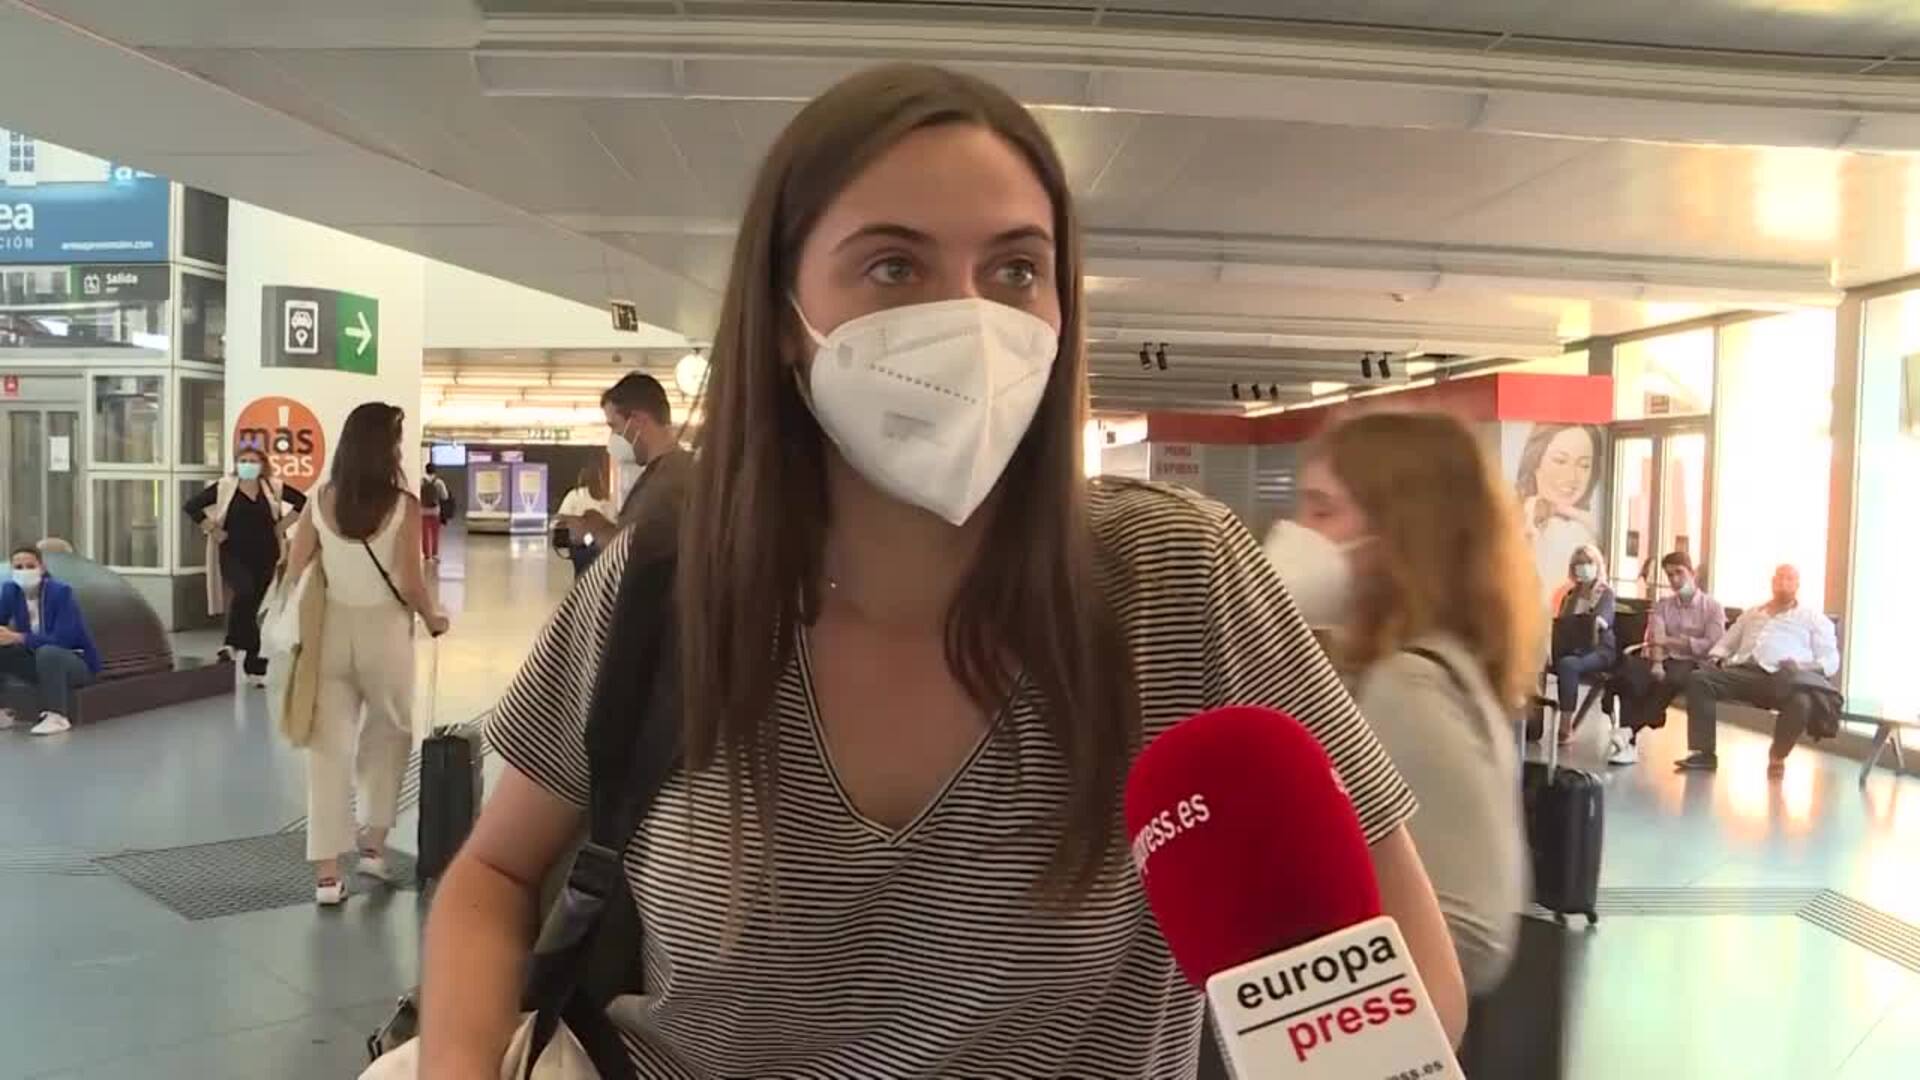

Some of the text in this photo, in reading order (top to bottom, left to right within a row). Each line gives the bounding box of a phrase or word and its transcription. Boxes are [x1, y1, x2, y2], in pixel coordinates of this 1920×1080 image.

[106, 272, 138, 285] Salida
[268, 455, 313, 477] sas
[1237, 934, 1397, 1010] europa
[1286, 986, 1417, 1062] press
